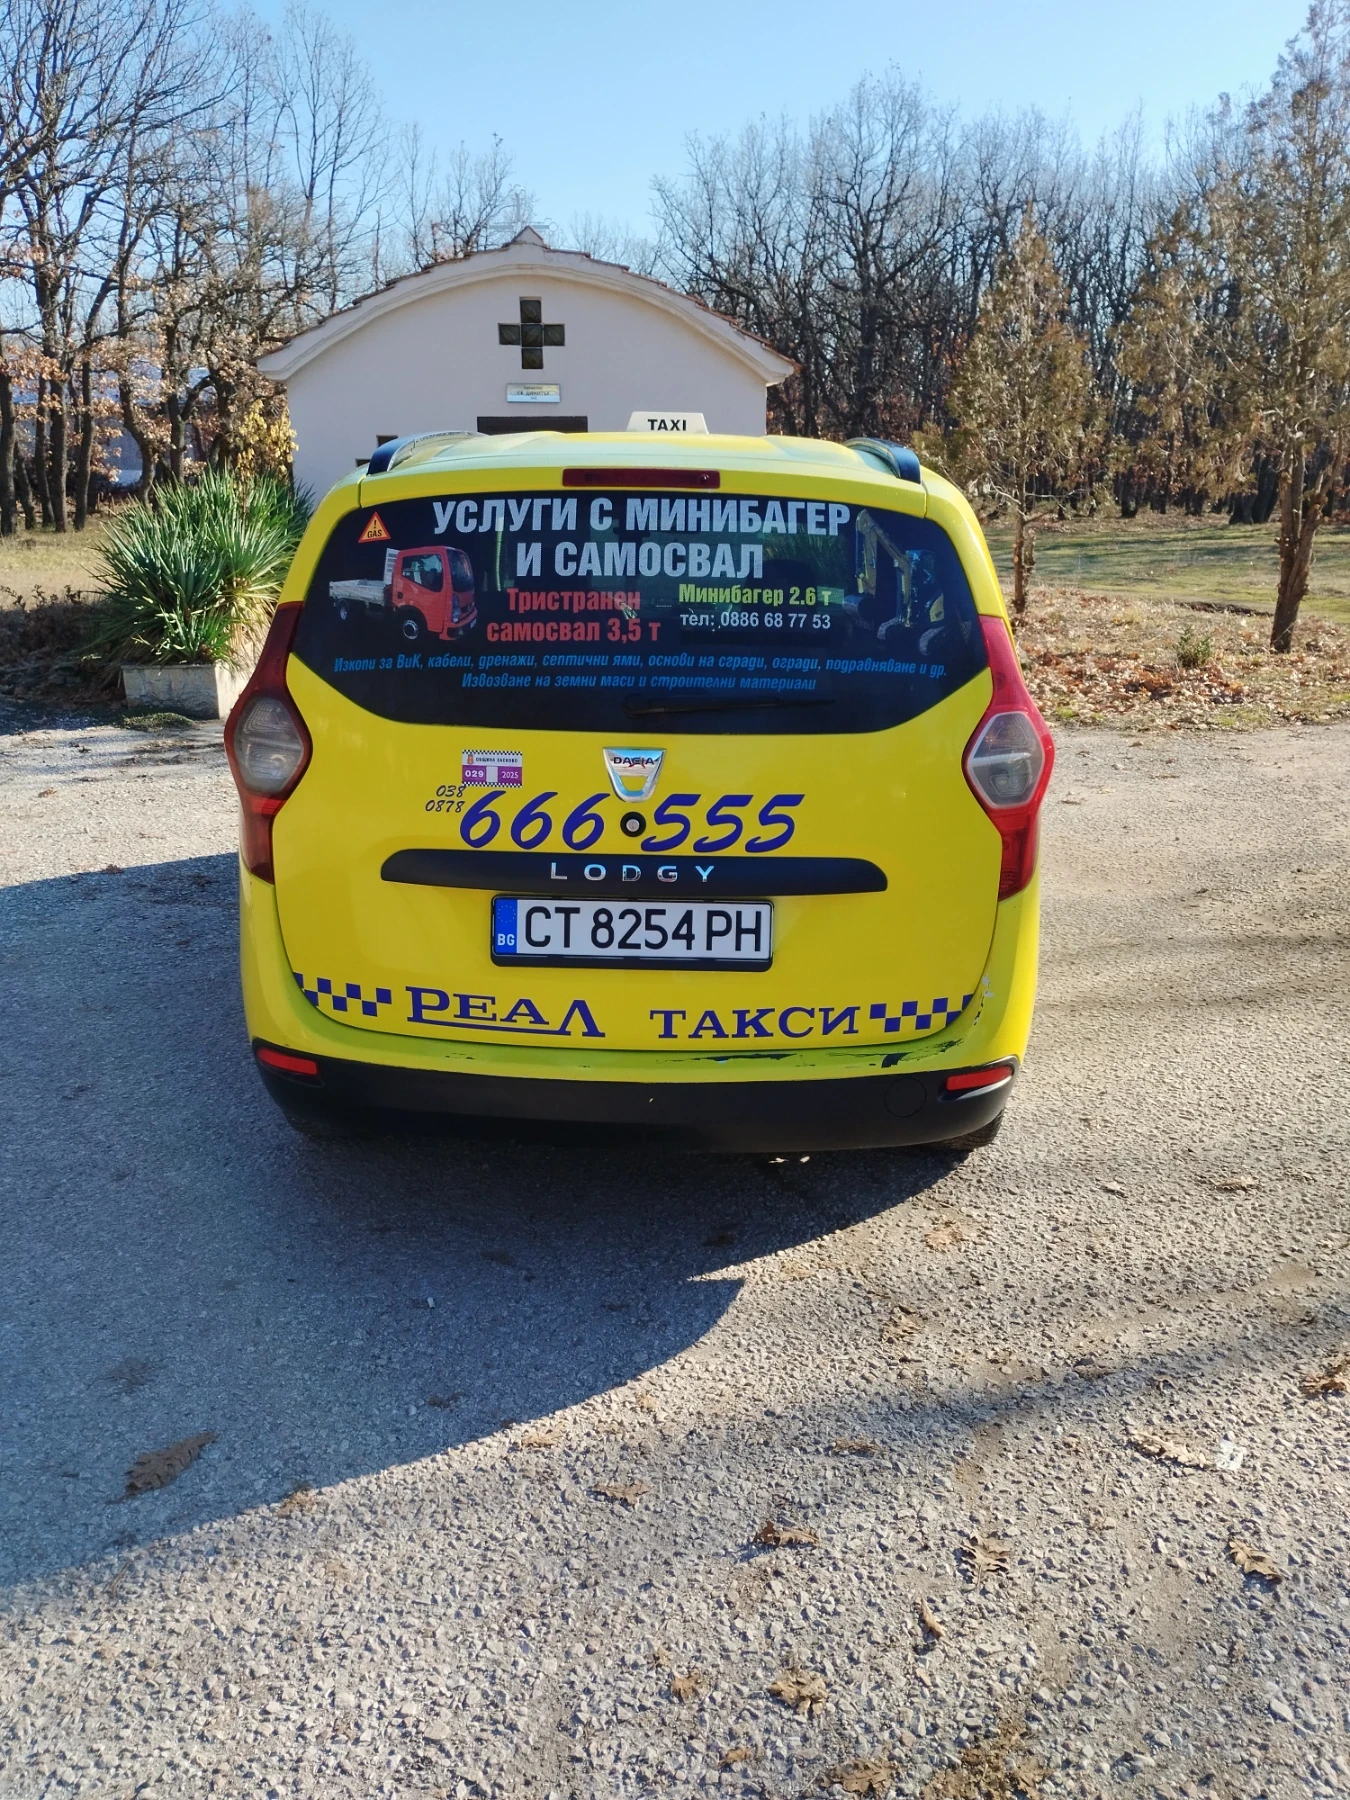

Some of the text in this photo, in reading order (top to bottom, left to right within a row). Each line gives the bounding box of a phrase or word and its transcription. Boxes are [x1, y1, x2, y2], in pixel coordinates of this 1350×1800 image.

[647, 419, 687, 431] TAXI
[433, 498, 851, 536] УСЛУГИ С МИНИБАГЕР
[366, 530, 383, 538] GAS
[516, 542, 763, 579] И САМОСВАЛ
[507, 588, 641, 613] Тристранен
[678, 584, 832, 607] Минибагер 2.6 т
[486, 618, 661, 643] самосвал 3,5 т
[680, 613, 831, 629] тел: 0886 68 77 53
[334, 653, 947, 678] Изкопи за ВиК, кабели, дренажи, септични ями, основи на сгради, огради, подравняване и др.
[461, 673, 817, 692] Извозване на земни маси и строителни материали
[613, 756, 655, 766] DACIA
[464, 769, 485, 778] 029
[501, 771, 520, 779] 2025
[436, 785, 467, 798] 038
[425, 800, 465, 813] 0878
[459, 790, 805, 853] 666 555
[550, 862, 715, 882] LODGY
[497, 932, 516, 946] BG
[524, 906, 762, 952] CT 8254 PH
[405, 985, 606, 1038] РЕАЛ
[650, 1005, 861, 1039] ТАКСИ
